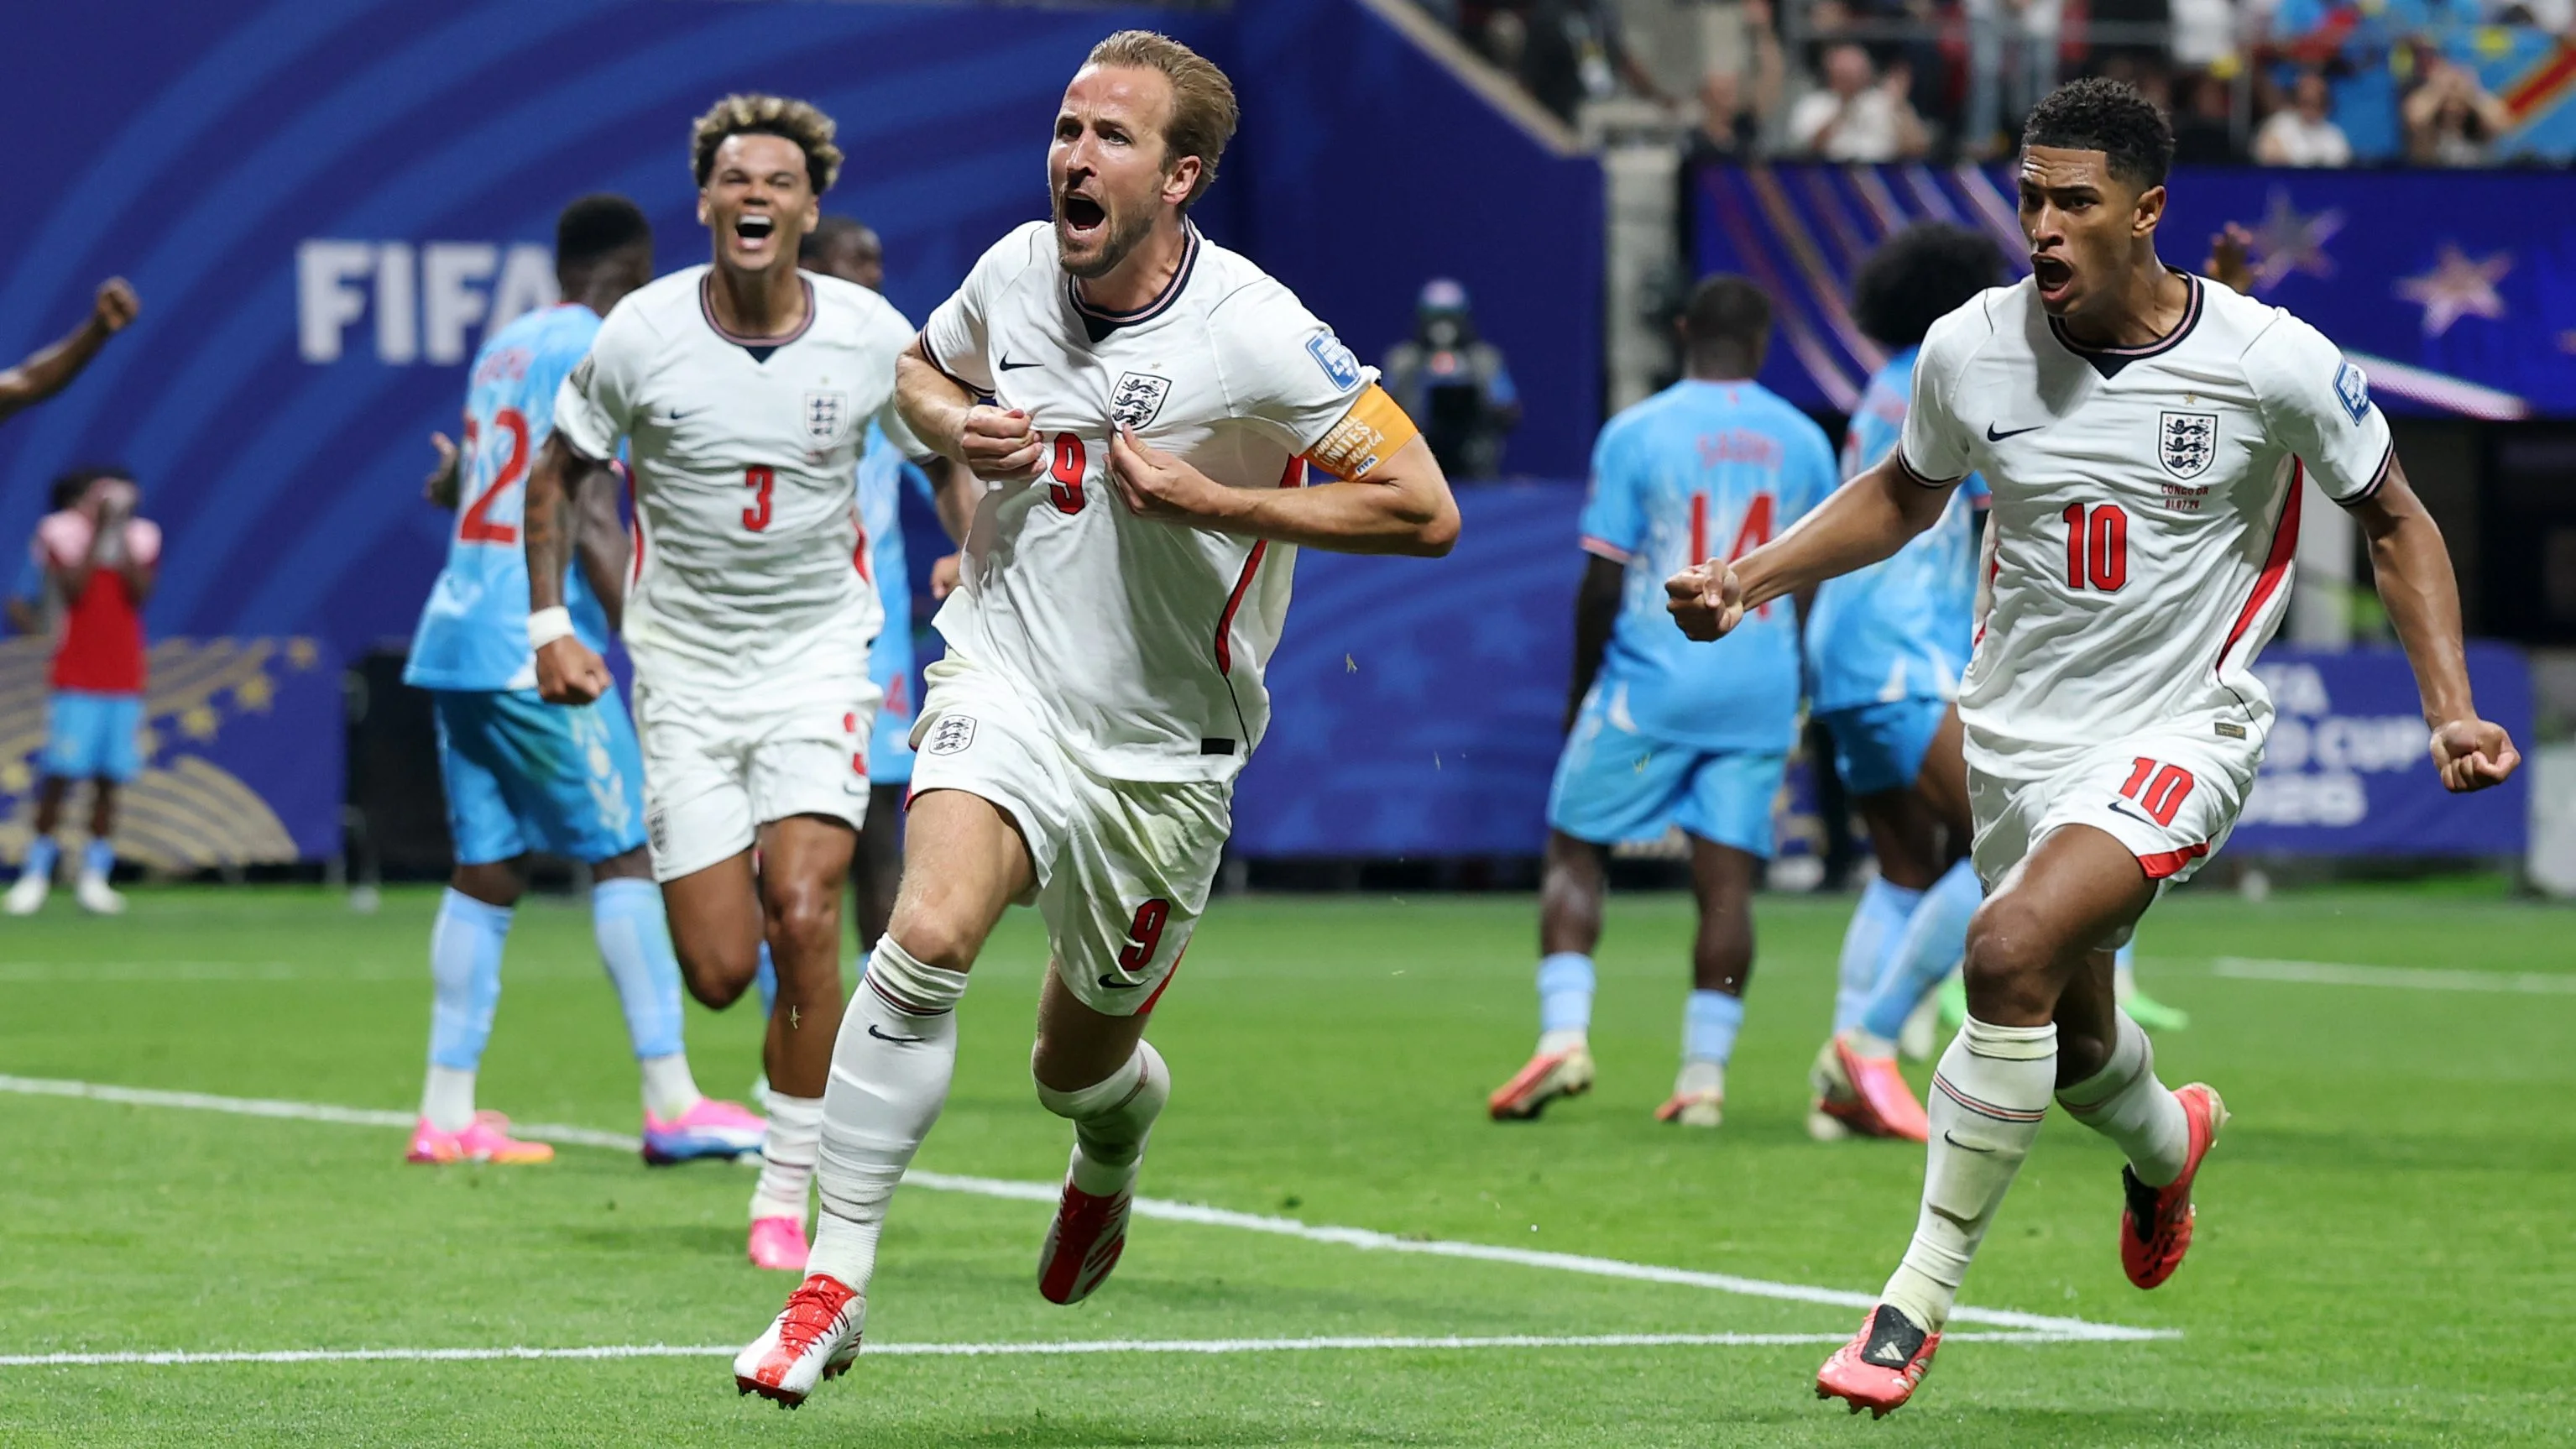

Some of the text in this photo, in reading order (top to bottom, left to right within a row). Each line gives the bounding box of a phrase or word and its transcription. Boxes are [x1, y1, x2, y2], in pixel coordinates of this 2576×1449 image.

[296, 239, 562, 364] FIFA
[1312, 414, 1360, 459] FOOTBALL
[1319, 421, 1371, 467] UNITES
[1356, 457, 1377, 473] FIFA
[461, 407, 530, 542] 2
[743, 464, 774, 532] 3
[1048, 432, 1086, 515] 9
[2161, 483, 2209, 496] CONGO DR
[1689, 489, 1773, 620] 14
[2063, 502, 2128, 593] 10
[2251, 663, 2330, 715] FA
[2119, 757, 2194, 828] 10
[1118, 898, 1171, 971] 9
